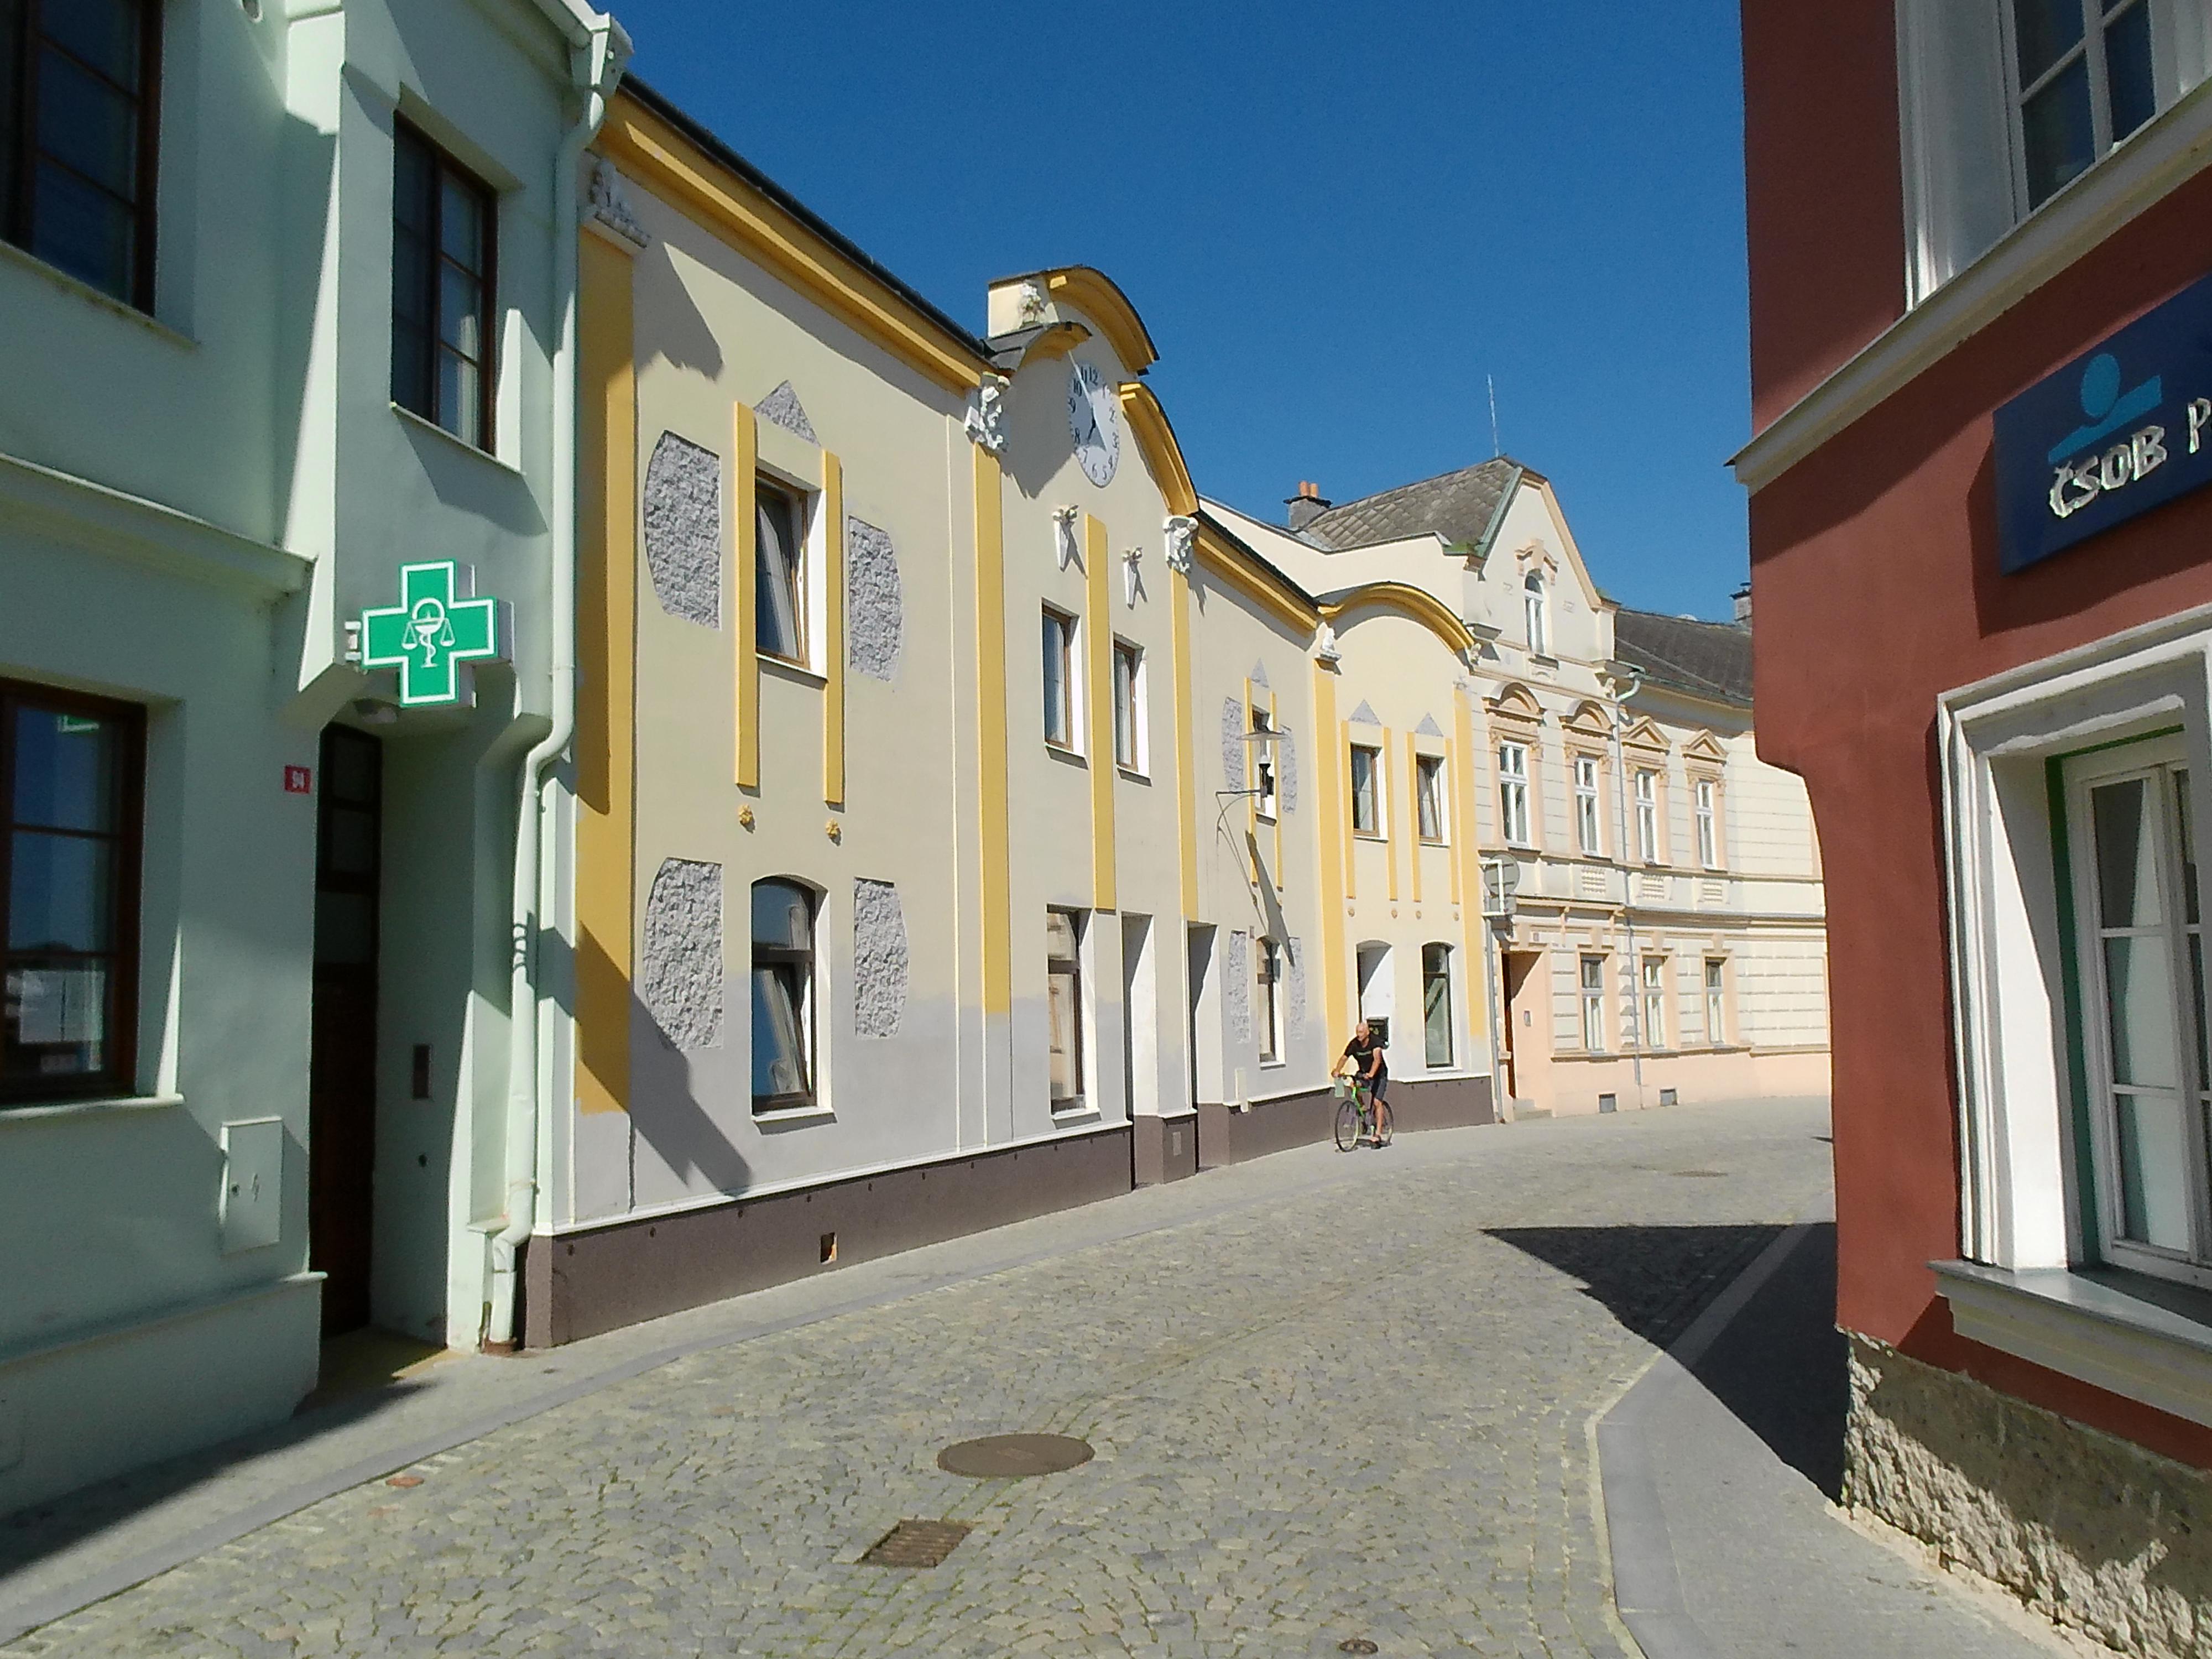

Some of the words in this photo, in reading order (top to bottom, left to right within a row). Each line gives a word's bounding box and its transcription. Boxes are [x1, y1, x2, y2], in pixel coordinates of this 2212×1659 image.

[1081, 367, 1087, 383] 11
[1089, 367, 1098, 386] 12
[1073, 378, 1082, 397] 10
[1068, 398, 1077, 414] 9
[1109, 406, 1115, 424] 2
[1074, 427, 1081, 445] 8
[1112, 432, 1119, 448] 3
[1083, 448, 1088, 463] 7
[1107, 455, 1113, 469] 4
[1092, 463, 1098, 478] 6
[1102, 465, 1107, 480] 5
[2049, 425, 2167, 519] ČSOB
